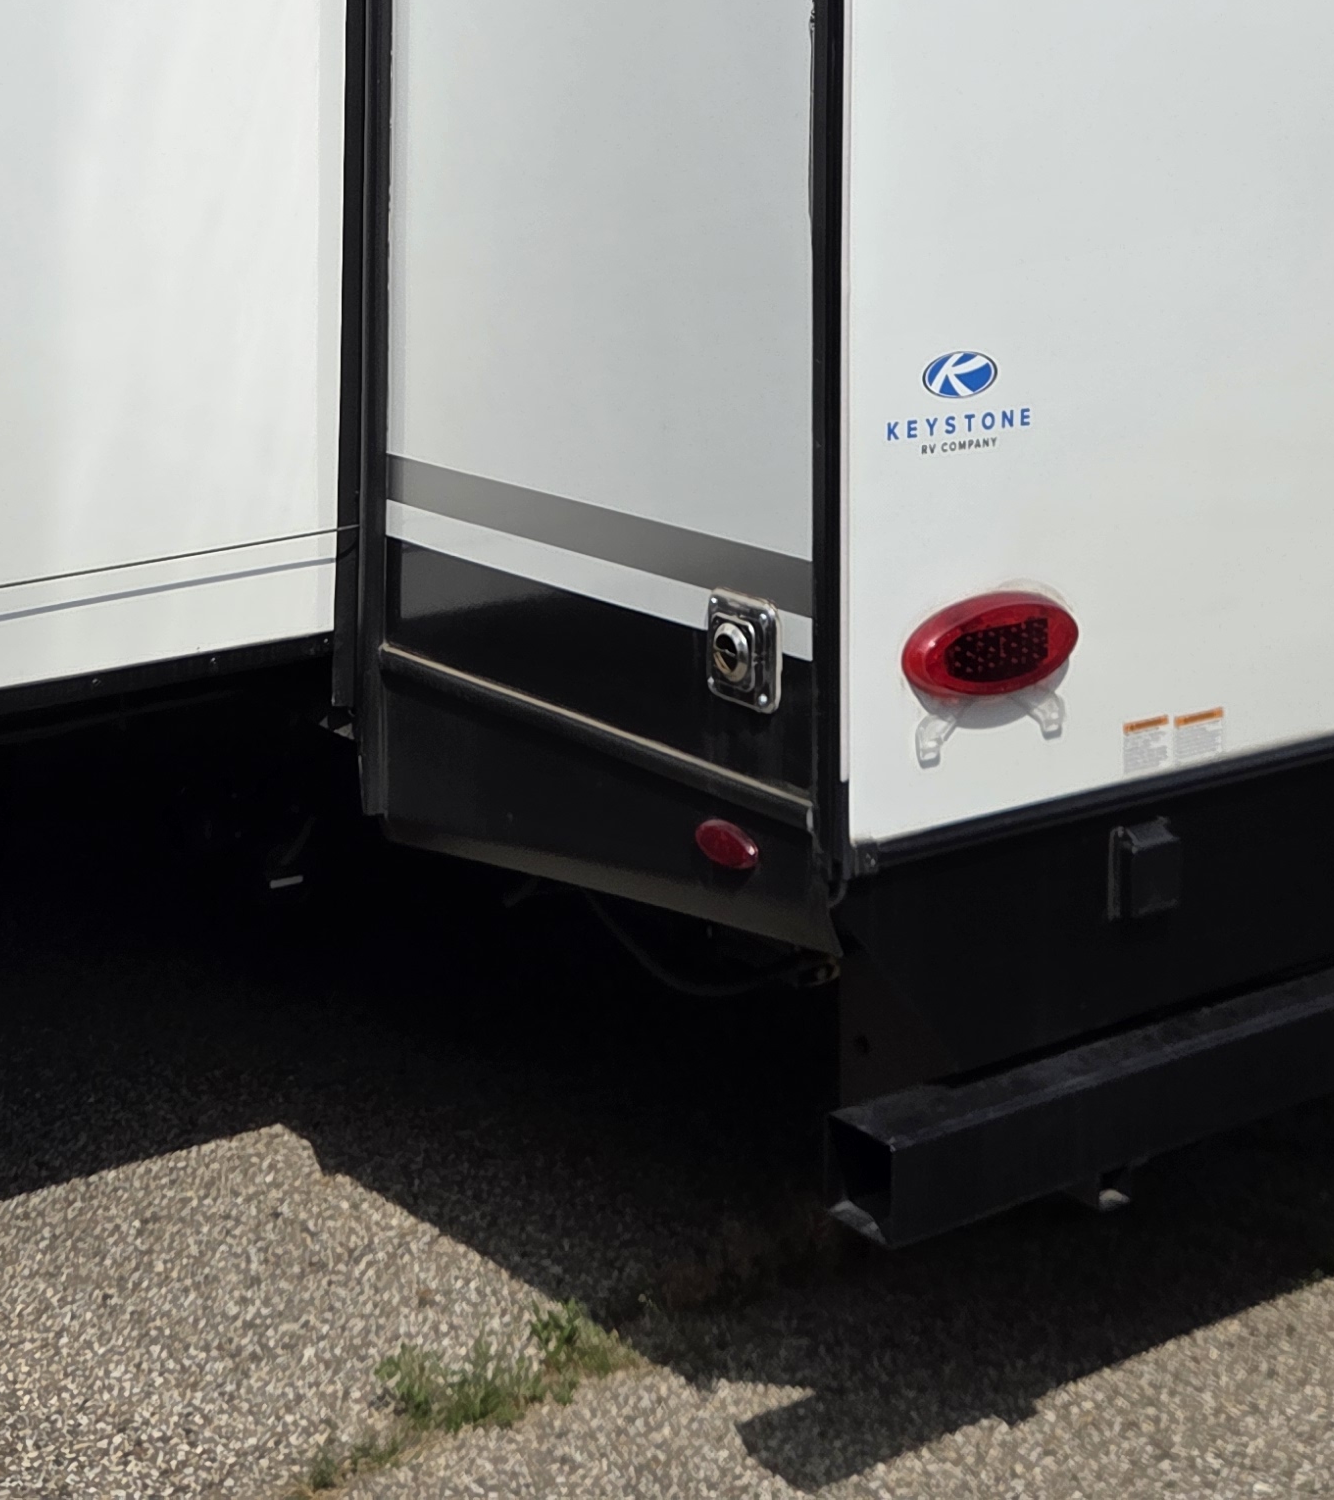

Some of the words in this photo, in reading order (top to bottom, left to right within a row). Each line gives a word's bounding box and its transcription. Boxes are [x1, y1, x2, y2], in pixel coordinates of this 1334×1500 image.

[886, 408, 1031, 441] KEYSTONE
[921, 443, 936, 455] RV
[941, 437, 997, 453] COMPANY
